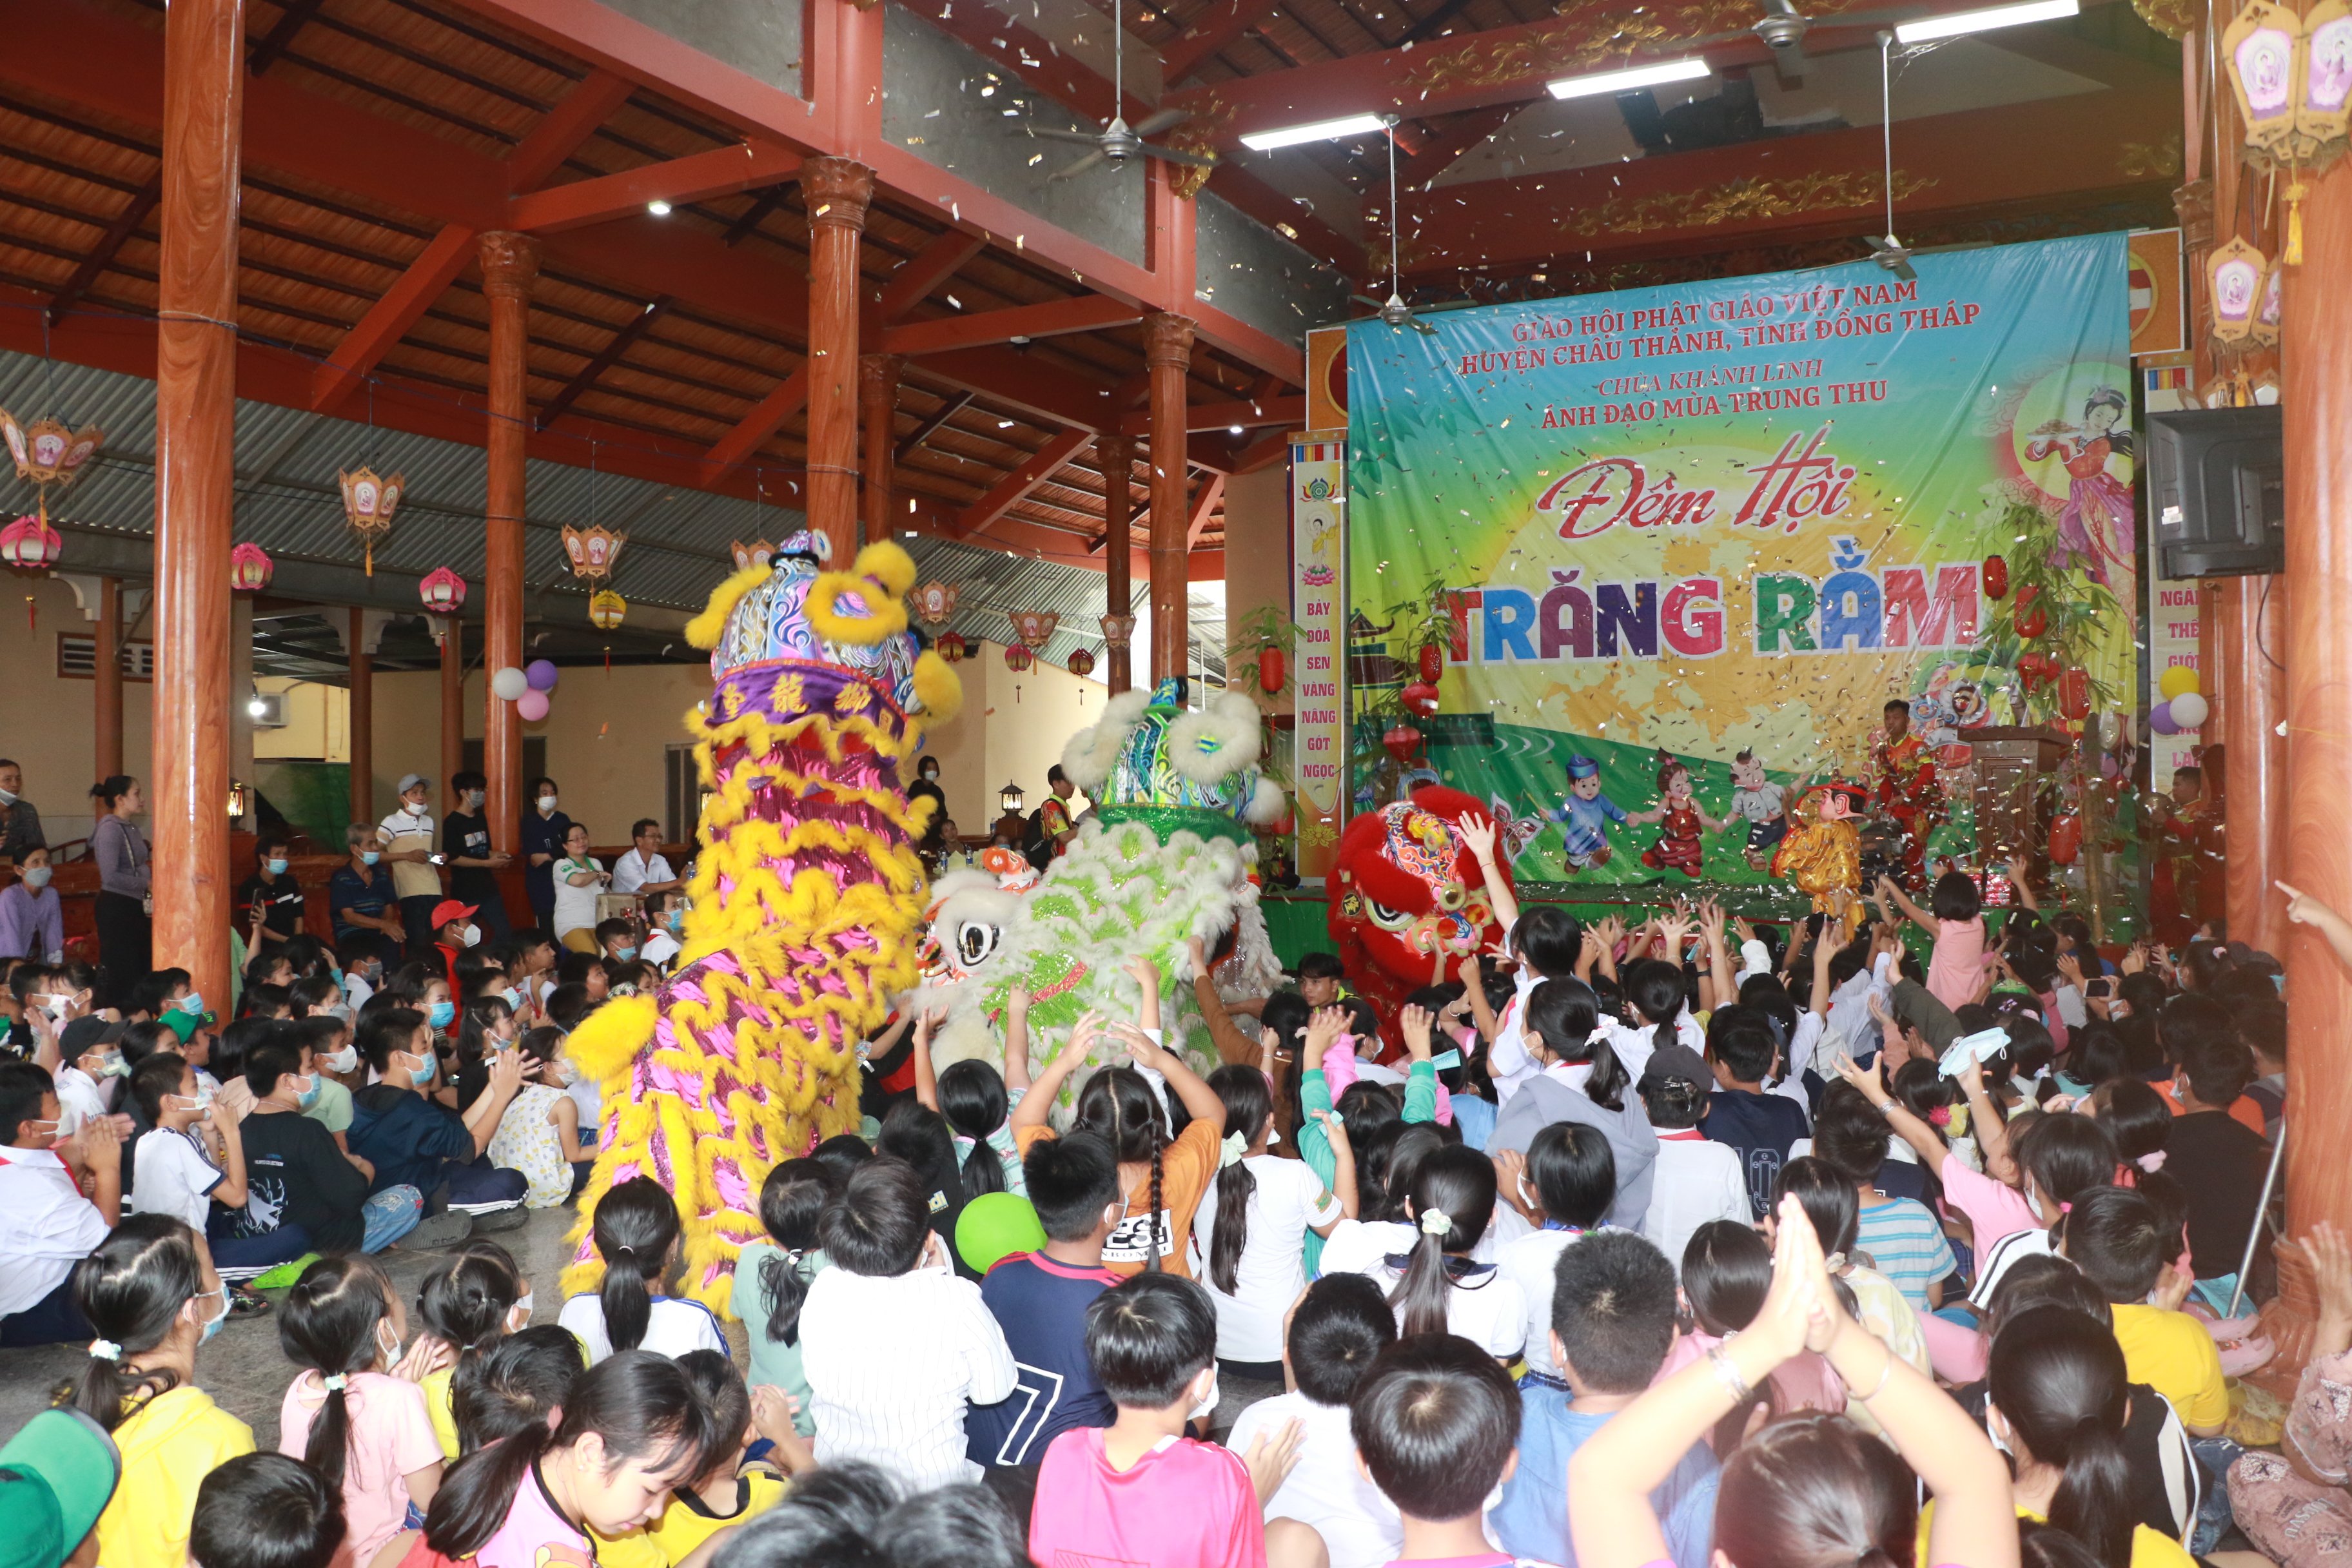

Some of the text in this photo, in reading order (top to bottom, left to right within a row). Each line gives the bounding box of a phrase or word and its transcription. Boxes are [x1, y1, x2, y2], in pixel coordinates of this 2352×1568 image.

[1512, 280, 1917, 342] GIÁO HỘI PHẬT GIÁO VIỆT NAM
[1461, 345, 1545, 375] HUYỆN
[1553, 338, 1622, 365] CHÂU
[1739, 320, 1807, 347] TỈNH
[1815, 308, 1892, 340] ĐỒNG
[1900, 300, 1980, 331] THÁP
[1598, 359, 1823, 396] CHÙA KHÁNH LINH
[1541, 380, 1888, 429] ÁNH ĐẠO MÙA TRUNG THU
[1537, 426, 1856, 540] Đêm Hội
[1436, 540, 1977, 662] TRĂNG RẰM
[2160, 587, 2199, 606] NGÀ
[1307, 599, 1331, 616] BẢY
[1307, 656, 1331, 670] SEN
[1302, 681, 1335, 697] VÀNG
[1302, 709, 1336, 723] NÂNG
[1308, 735, 1331, 750] GÓT
[1303, 764, 1335, 779] NGỌC
